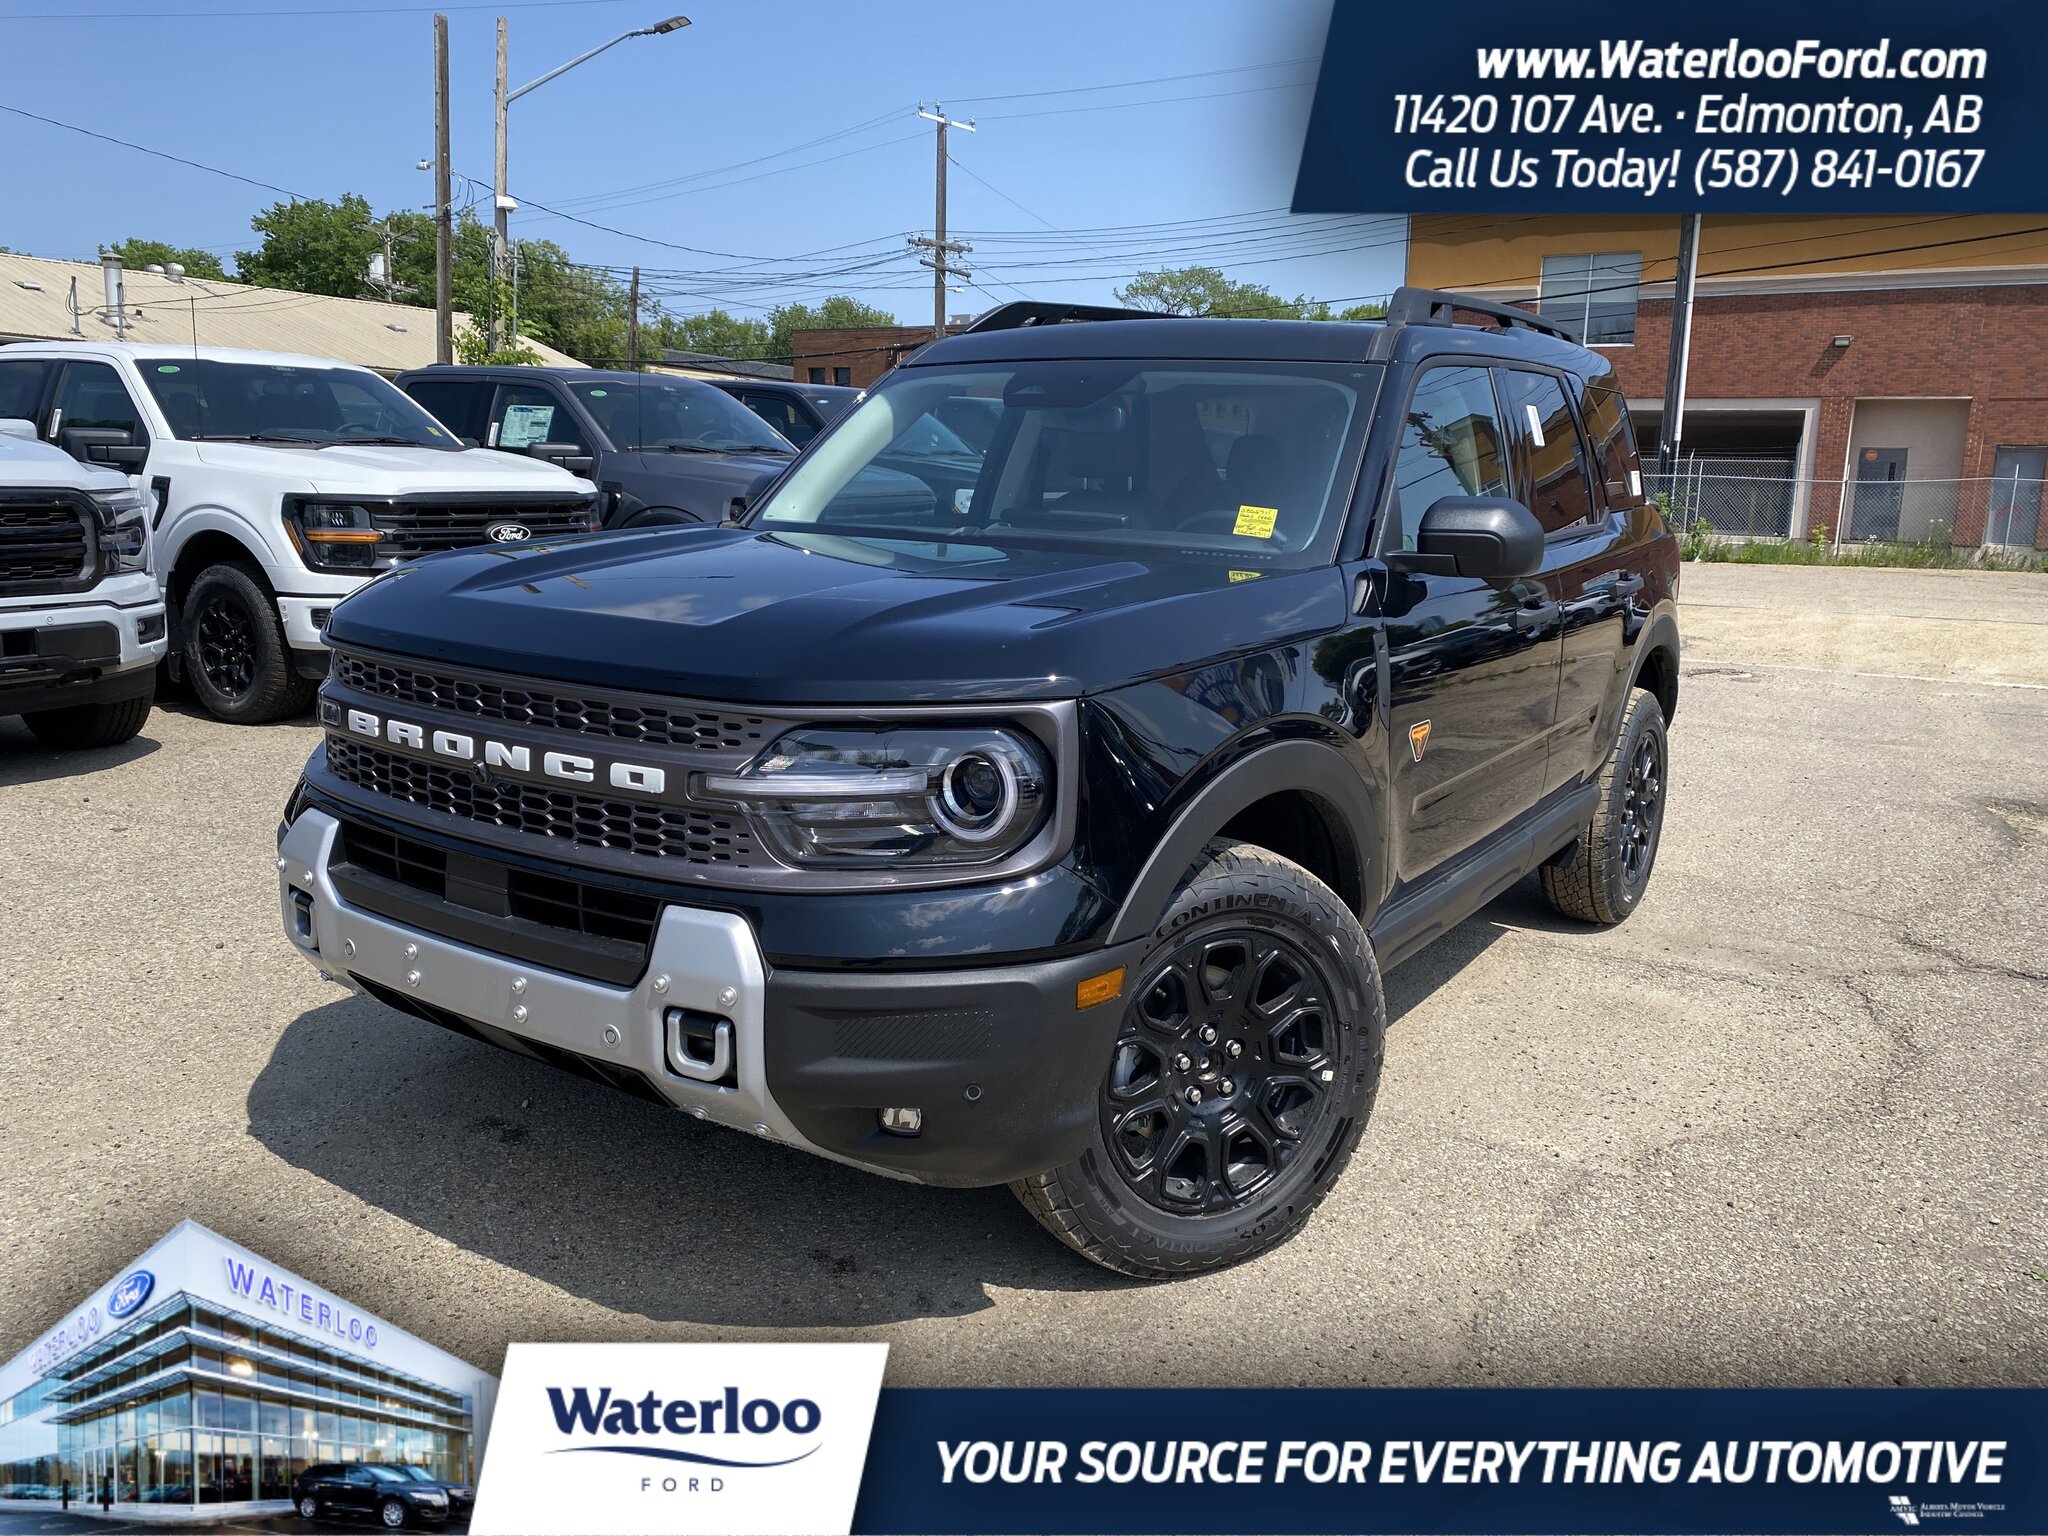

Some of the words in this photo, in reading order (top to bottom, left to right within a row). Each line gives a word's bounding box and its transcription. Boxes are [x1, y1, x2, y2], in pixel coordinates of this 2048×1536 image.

[498, 527, 524, 541] Ford
[347, 708, 666, 794] BRONCO
[1155, 893, 1321, 939] CONTINENTA
